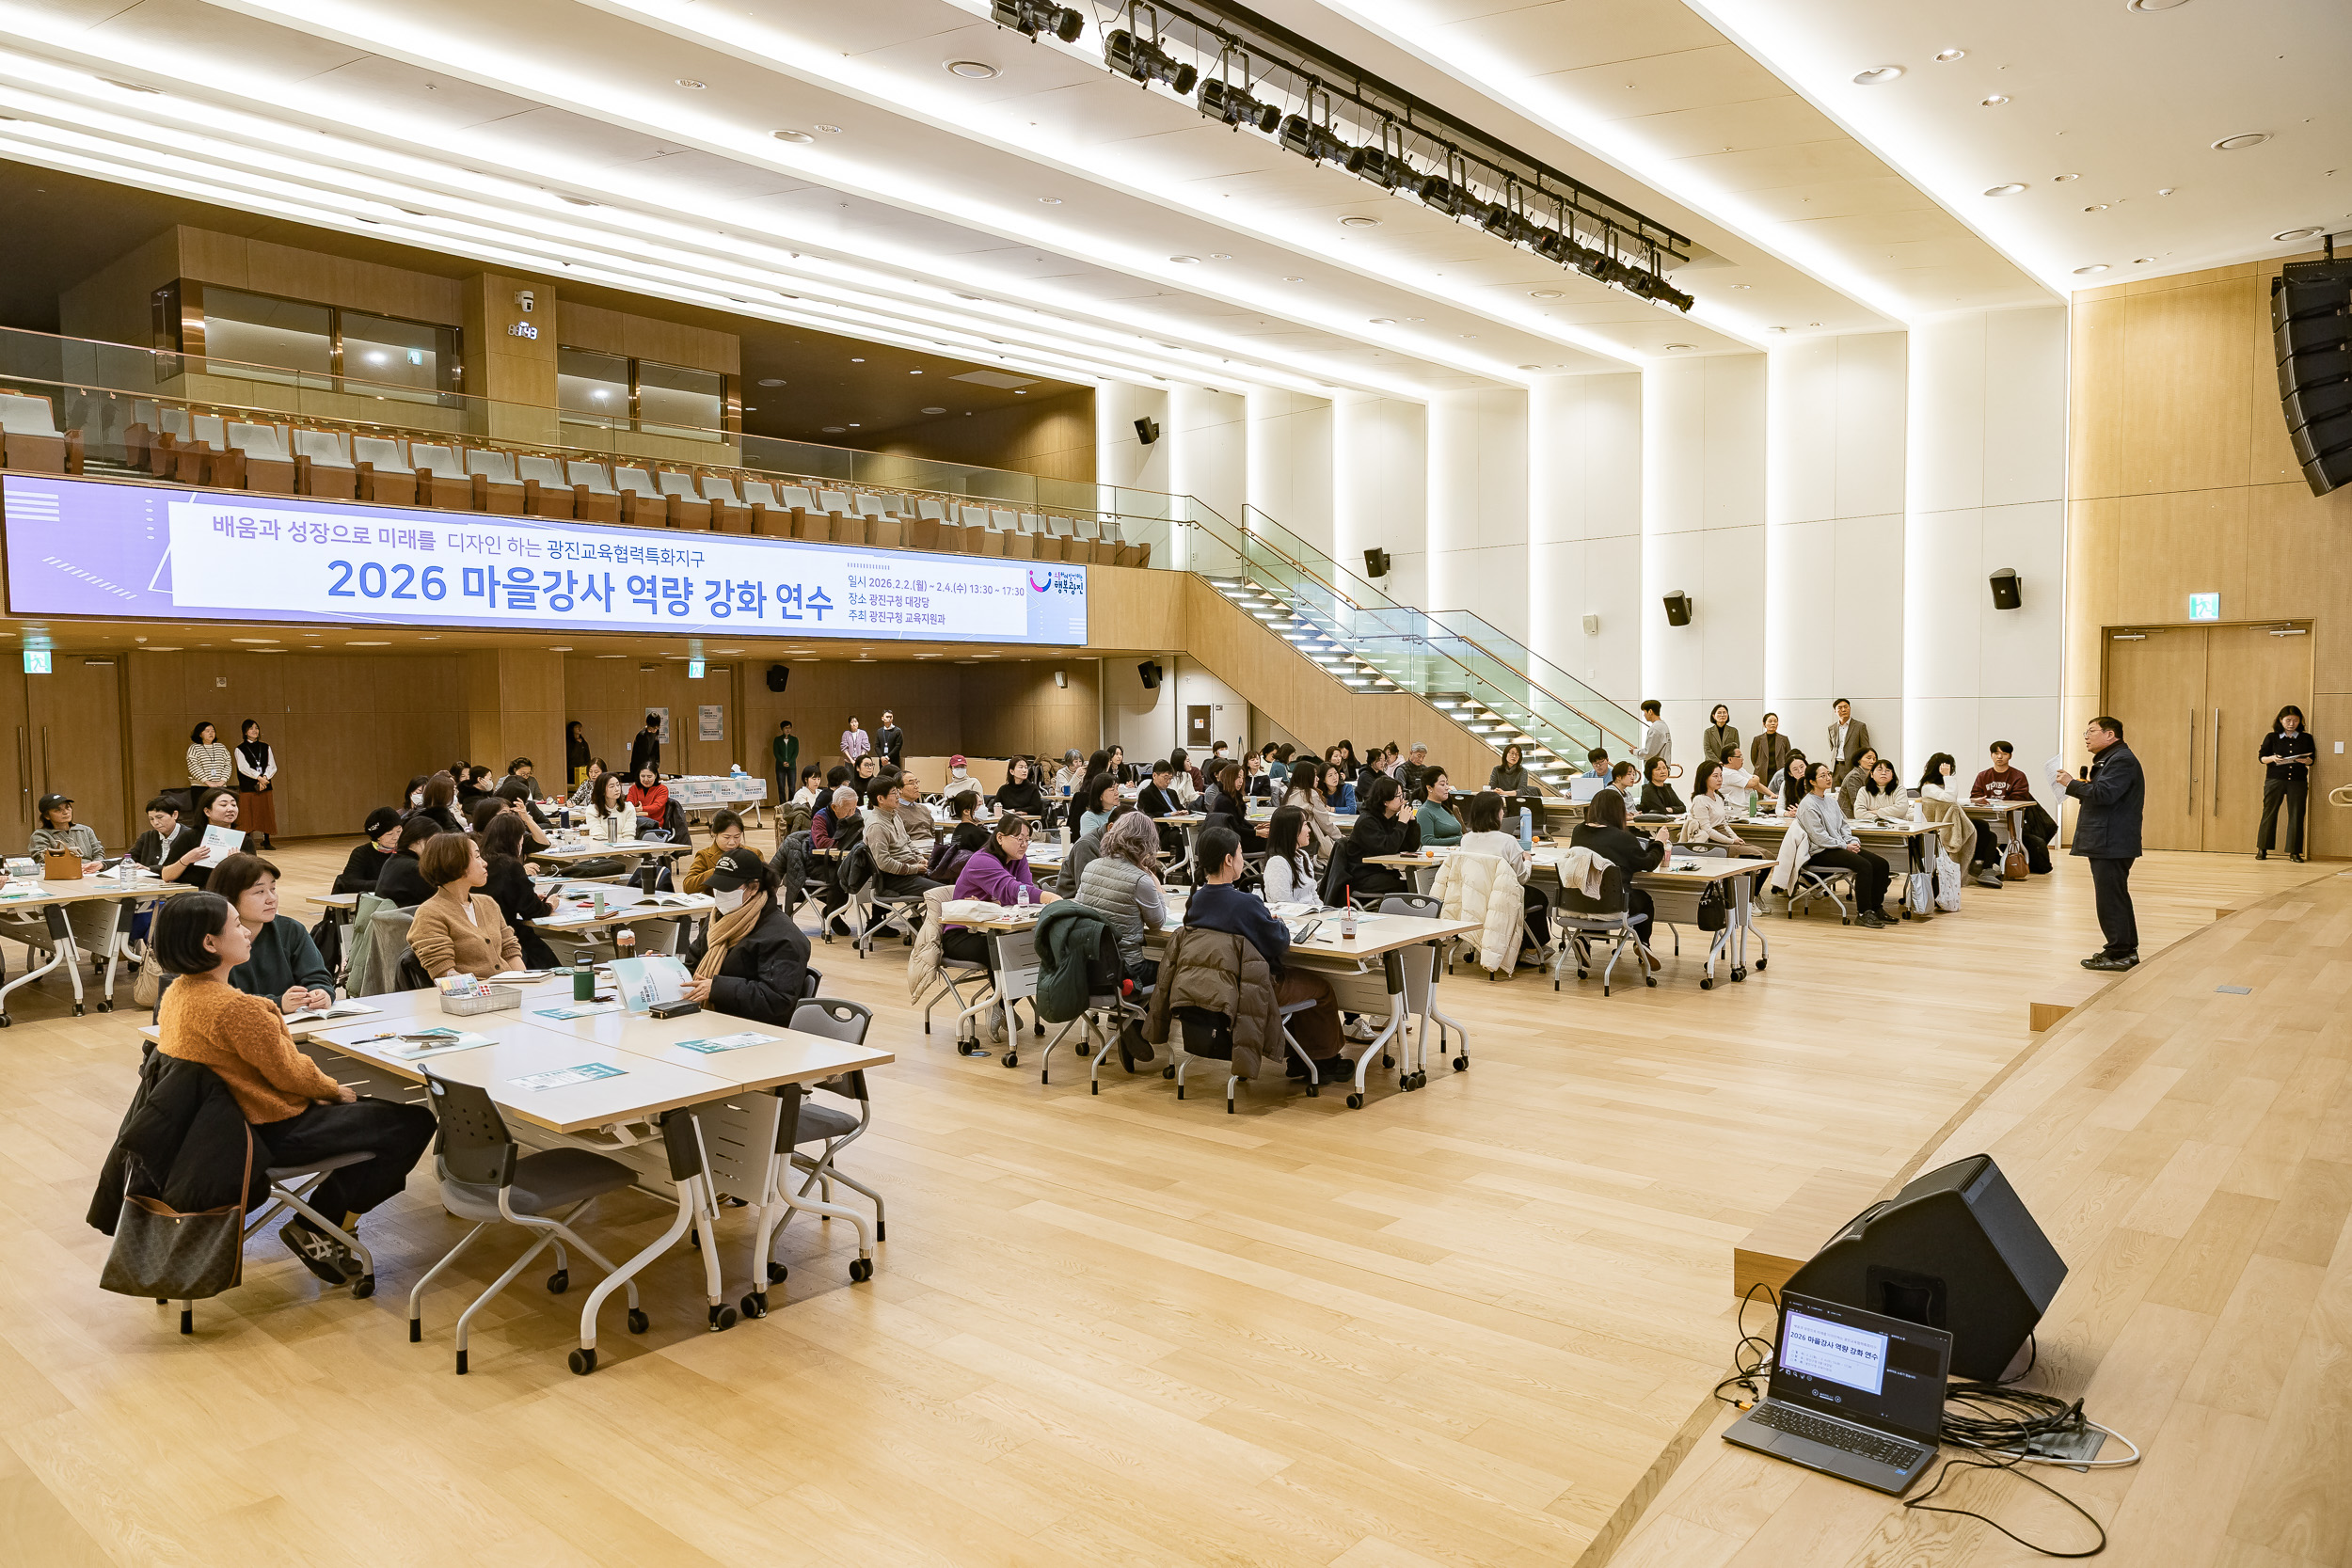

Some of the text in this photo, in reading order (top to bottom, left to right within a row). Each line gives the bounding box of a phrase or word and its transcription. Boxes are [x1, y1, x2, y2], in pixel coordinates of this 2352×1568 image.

[213, 515, 706, 568] 배움과 성장으로 미래를 디자인 하는 광진교육협력특화지구
[327, 560, 834, 622] 2026 마을강사 역량 강화 연수
[848, 575, 866, 588] 일시
[868, 578, 928, 593] 2026.2.2.(월)
[936, 582, 967, 594] 2.4.(수)
[969, 584, 993, 594] 13:30
[1002, 586, 1025, 596] 17:30
[1054, 579, 1084, 595] 행복광진
[848, 593, 930, 609] 장소 광진구청 대강당
[848, 610, 946, 626] 주최 광진구청 교육지원과
[1789, 1331, 1806, 1341] 2026
[1807, 1336, 1835, 1349] 마을강사
[1835, 1342, 1849, 1354] 역량
[1850, 1347, 1864, 1357] 강화
[1865, 1351, 1879, 1361] 연수
